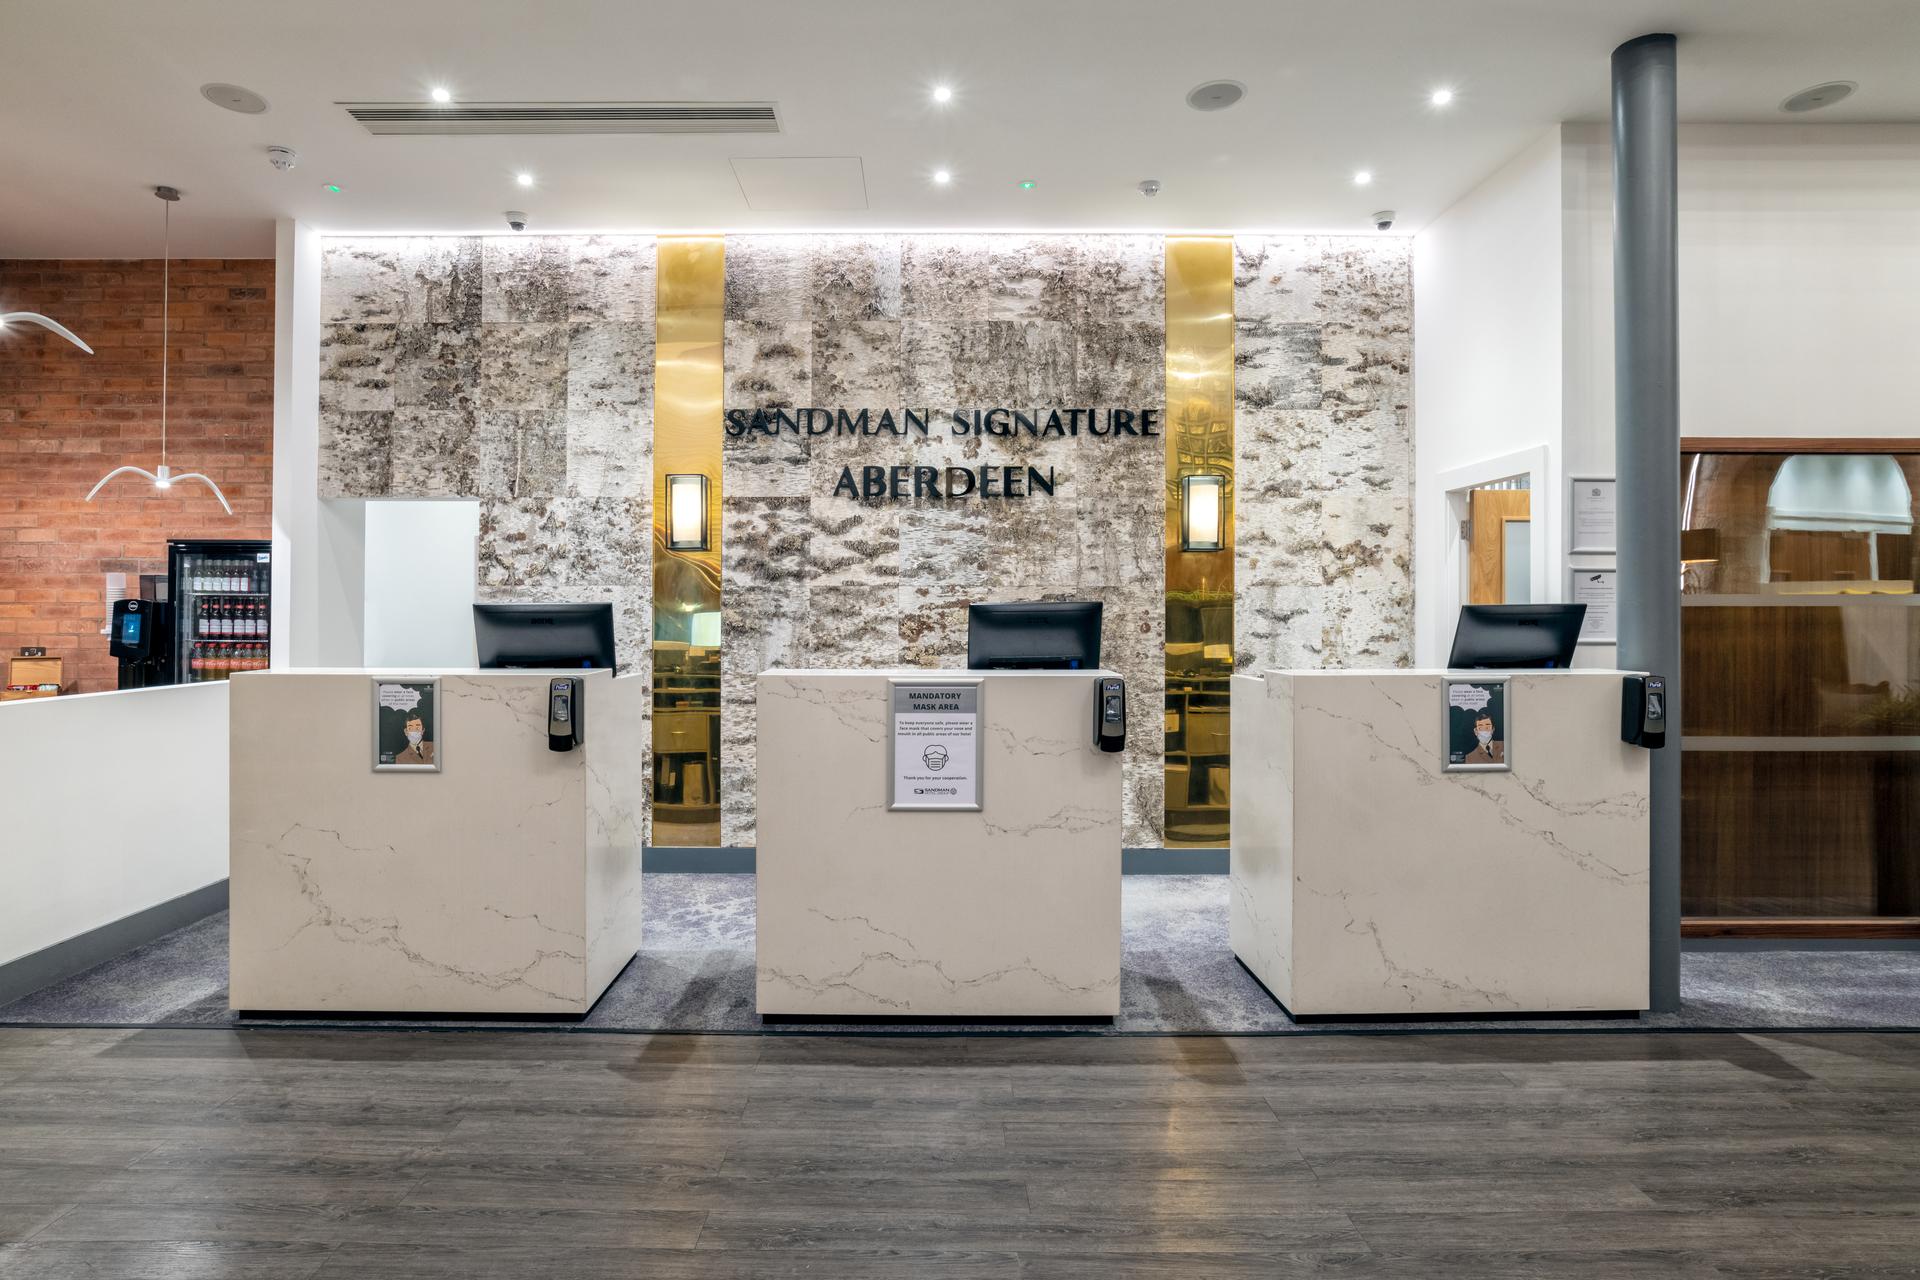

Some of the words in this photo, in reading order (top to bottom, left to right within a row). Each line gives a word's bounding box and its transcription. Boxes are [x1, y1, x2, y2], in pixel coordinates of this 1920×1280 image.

[725, 408, 929, 437] SANDMAN
[951, 408, 1160, 437] SIGNATURE
[833, 465, 1055, 498] ABERDEEN
[909, 692, 961, 700] MANDATORY
[913, 703, 936, 711] MASK
[938, 703, 959, 711] AREA
